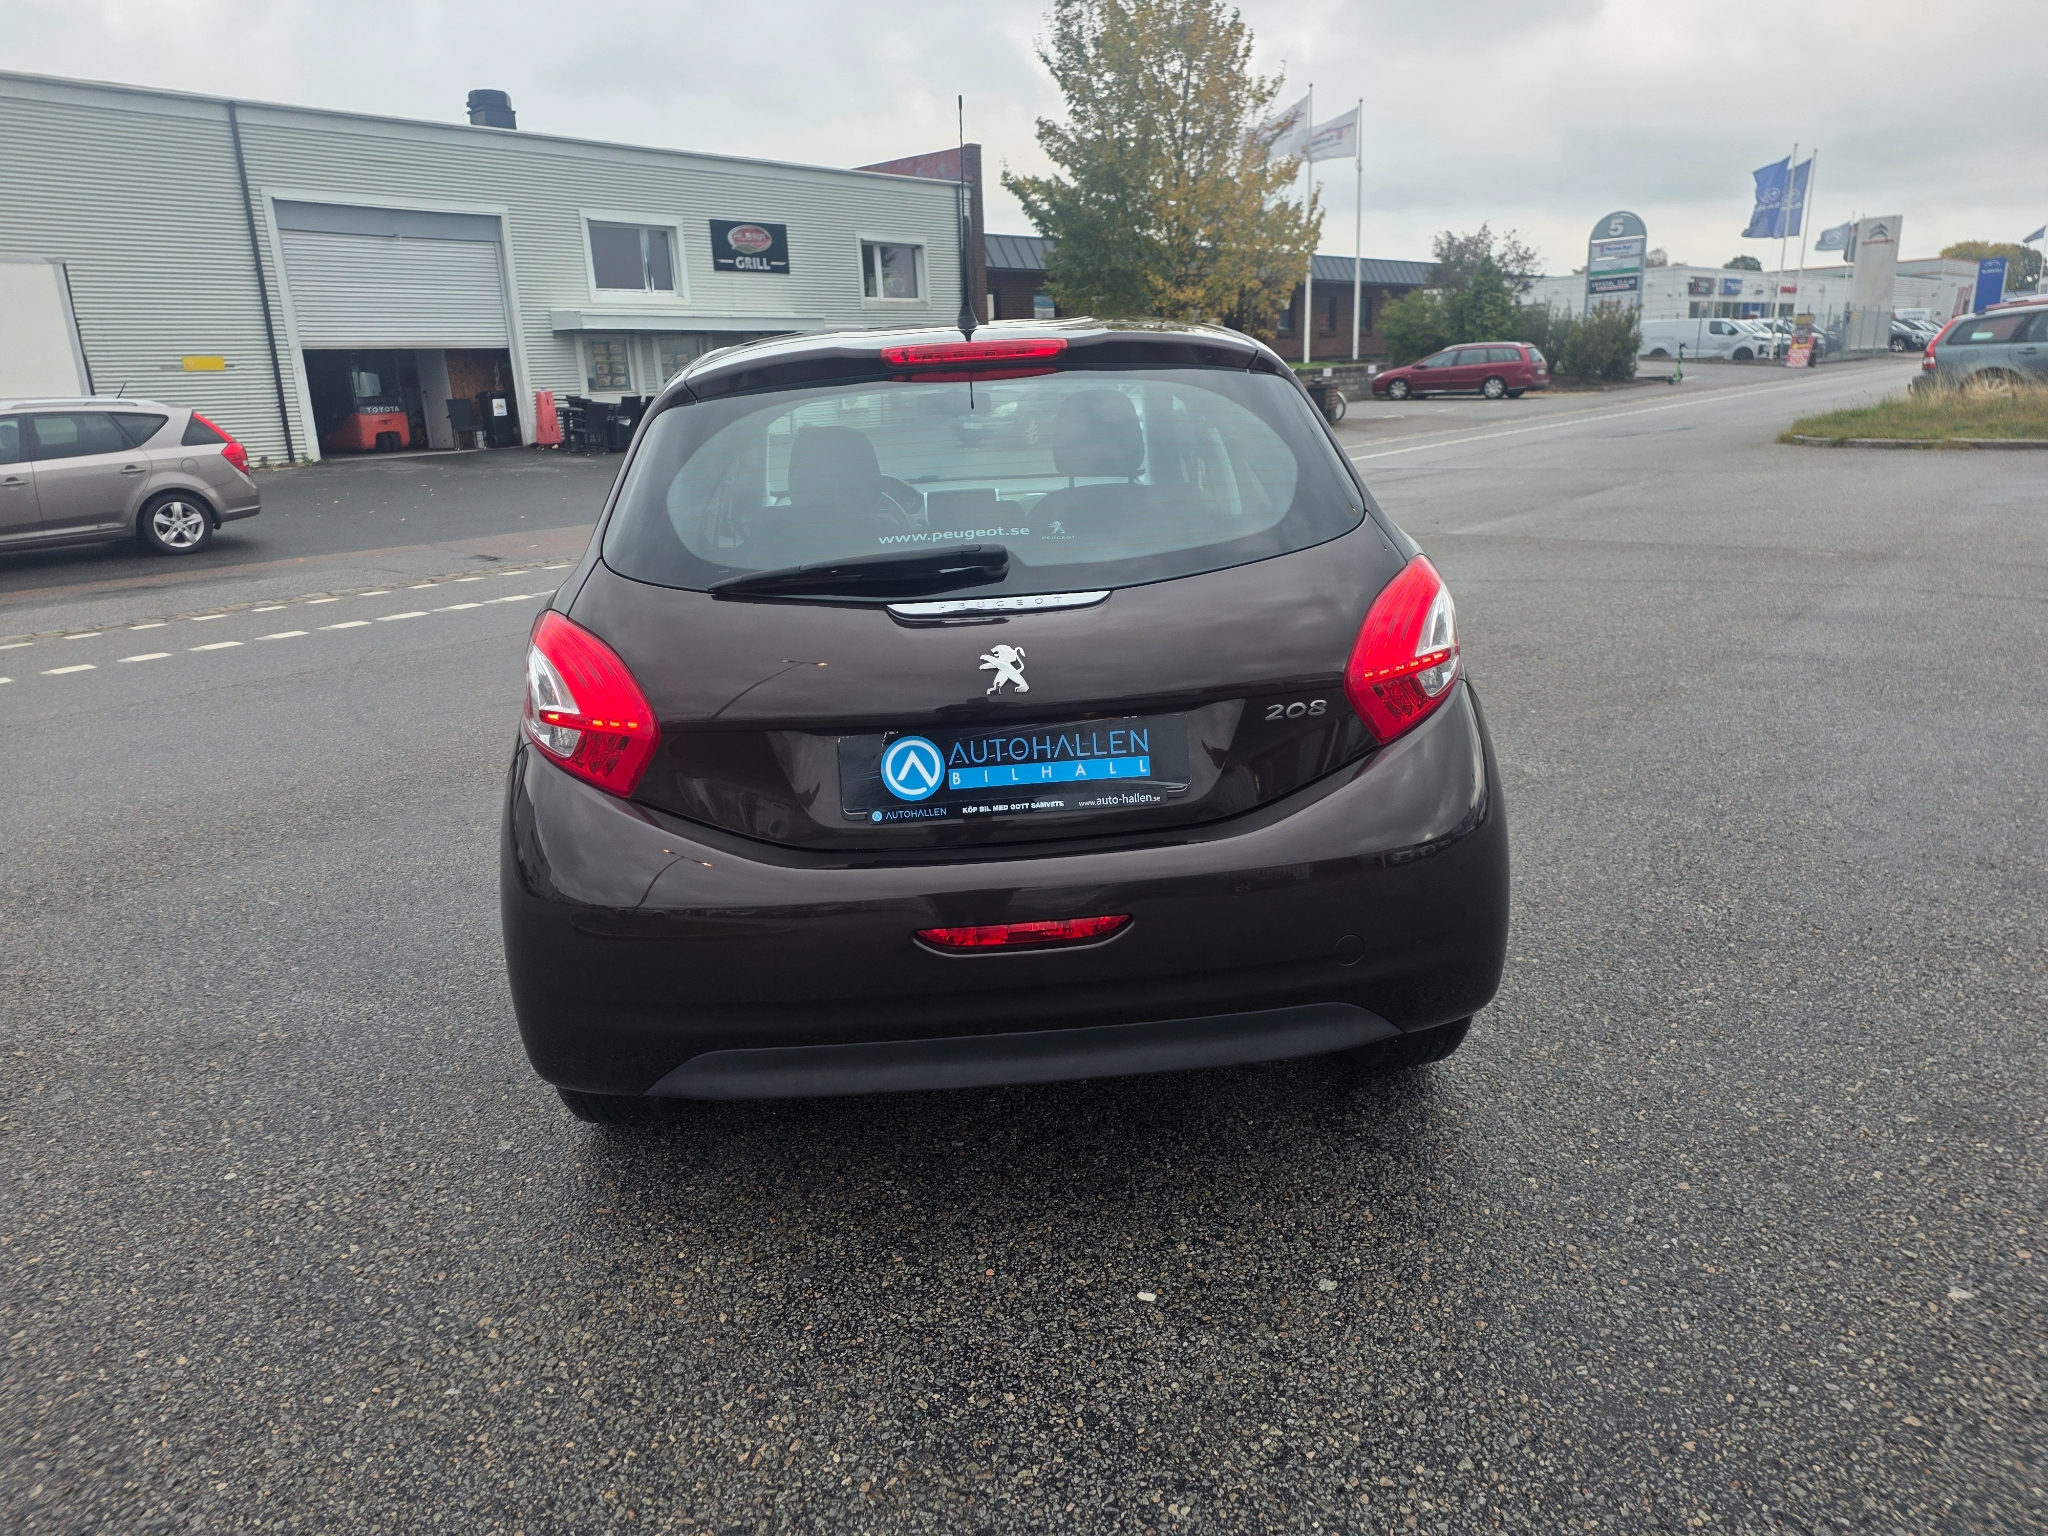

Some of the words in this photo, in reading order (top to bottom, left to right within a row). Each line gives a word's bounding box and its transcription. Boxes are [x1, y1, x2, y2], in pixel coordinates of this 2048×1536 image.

[1608, 217, 1624, 237] 5
[735, 256, 771, 270] GRILL
[366, 405, 400, 414] TOYOTA
[878, 526, 1030, 545] www.peugeot.se
[939, 596, 1062, 611] PEUGEOT
[1264, 699, 1328, 721] 208
[948, 728, 1149, 766] AUTOHALLEN
[1078, 792, 1161, 807] www.auto-hallen.se
[885, 807, 947, 820] AUTOHALLEN
[962, 805, 978, 814] KÖP
[979, 805, 992, 813] BIL
[992, 804, 1008, 812] MED
[1010, 803, 1030, 811] GOTT
[1030, 801, 1065, 809] SAMVETE
